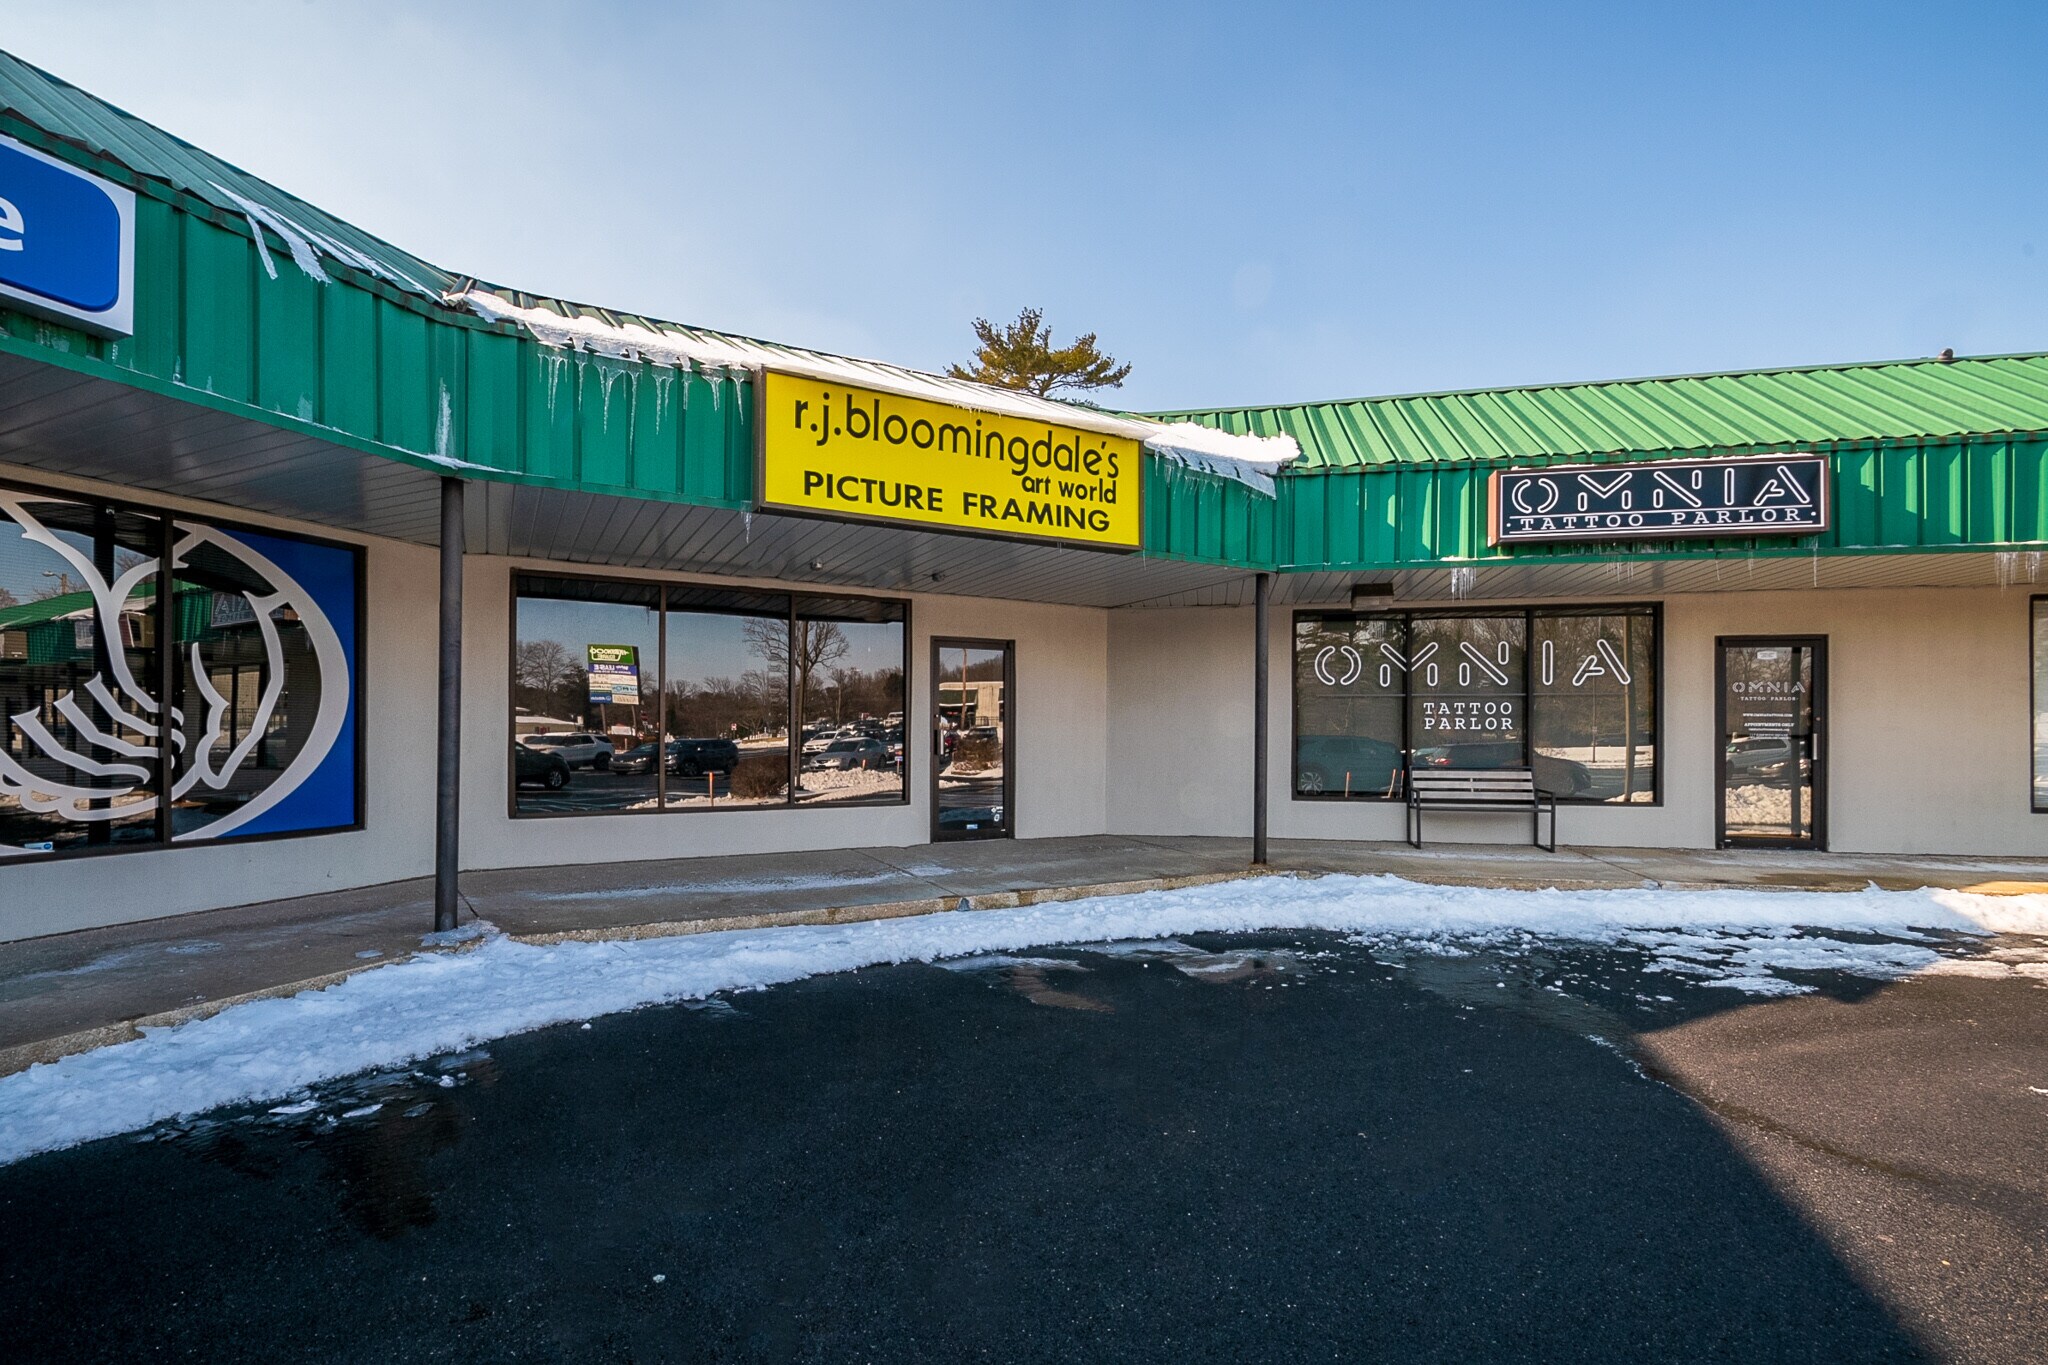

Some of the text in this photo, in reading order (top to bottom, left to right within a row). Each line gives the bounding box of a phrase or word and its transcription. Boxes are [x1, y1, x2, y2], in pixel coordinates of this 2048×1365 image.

[794, 391, 1119, 479] r.j.bloomingdale's
[803, 470, 1111, 532] PICTURE FRAMING
[1021, 475, 1117, 504] art world
[1511, 465, 1810, 514] OMNIA
[1520, 508, 1801, 531] TATTOO PARLOR
[1314, 639, 1631, 687] OMNIA
[1732, 681, 1806, 693] OMNIA
[1423, 702, 1513, 715] TATTOO
[1424, 717, 1514, 730] PARLOR
